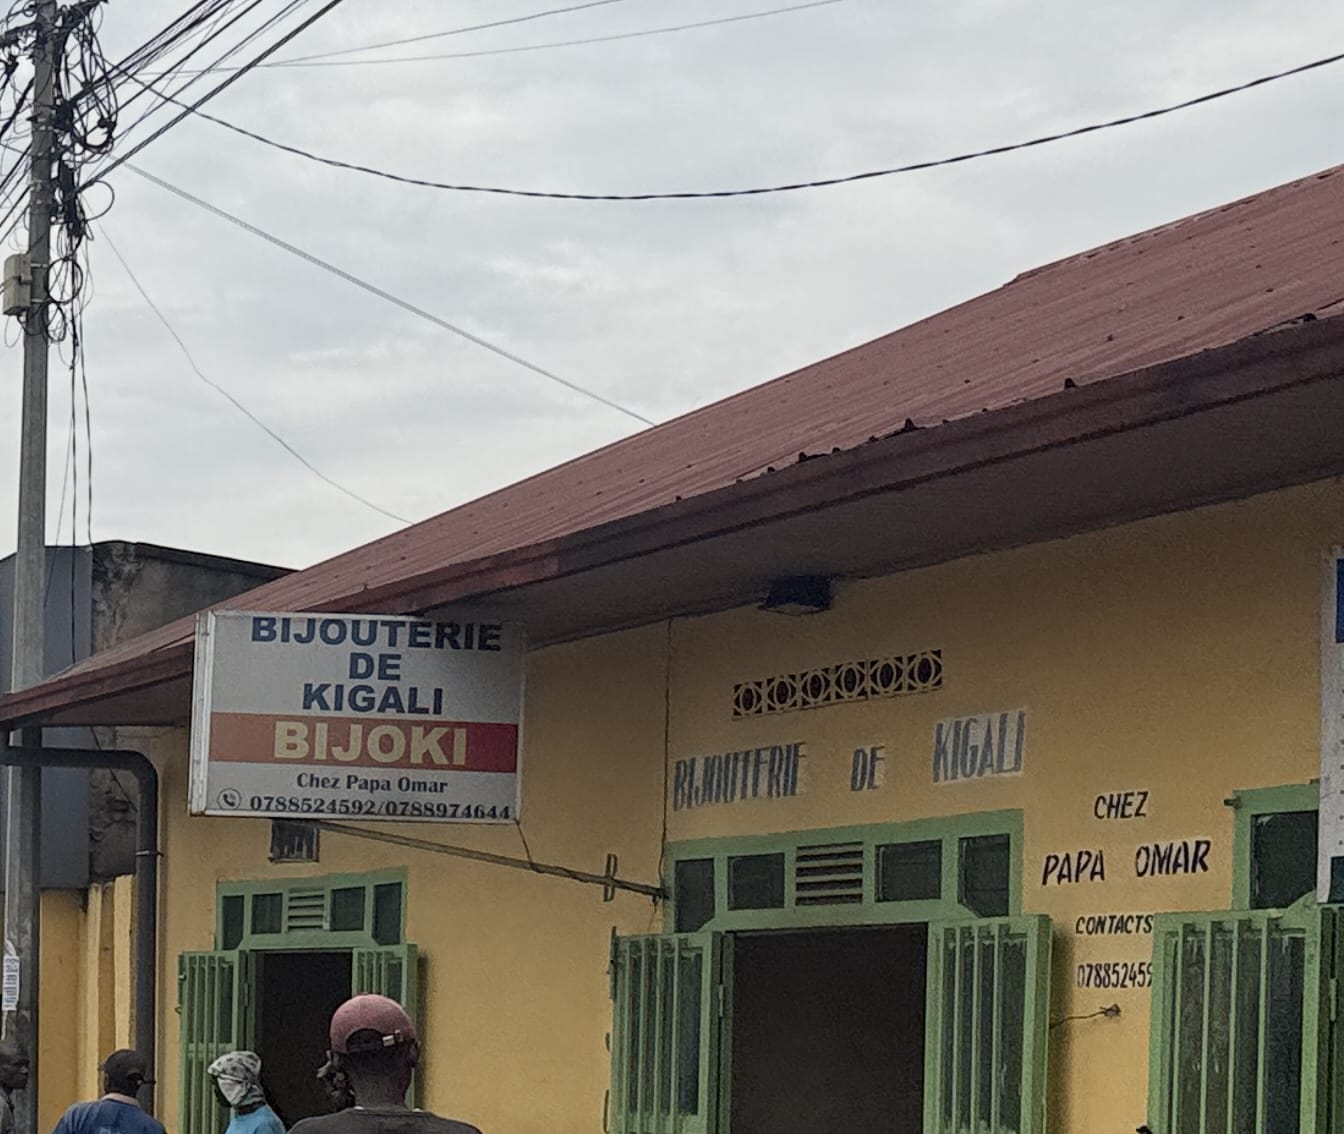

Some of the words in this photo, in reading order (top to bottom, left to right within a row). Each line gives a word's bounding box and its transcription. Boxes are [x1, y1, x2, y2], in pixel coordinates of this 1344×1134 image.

[251, 616, 502, 652] BIJOUTERIE
[349, 652, 402, 681] DE
[302, 683, 443, 715] KIGALI
[274, 720, 467, 766] BIJOKI
[850, 745, 886, 792] DE
[932, 710, 1025, 783] KIGALI
[296, 772, 340, 790] Chez
[346, 774, 392, 793] Papa
[398, 777, 448, 794] Omar
[250, 795, 510, 820] 0788524592/0788974644
[1094, 790, 1149, 819] CHEZ
[1042, 850, 1105, 886] PAPA
[1135, 839, 1211, 877] OMAR
[1075, 914, 1154, 935] CONTACTS
[1077, 961, 1153, 989] 078852459
